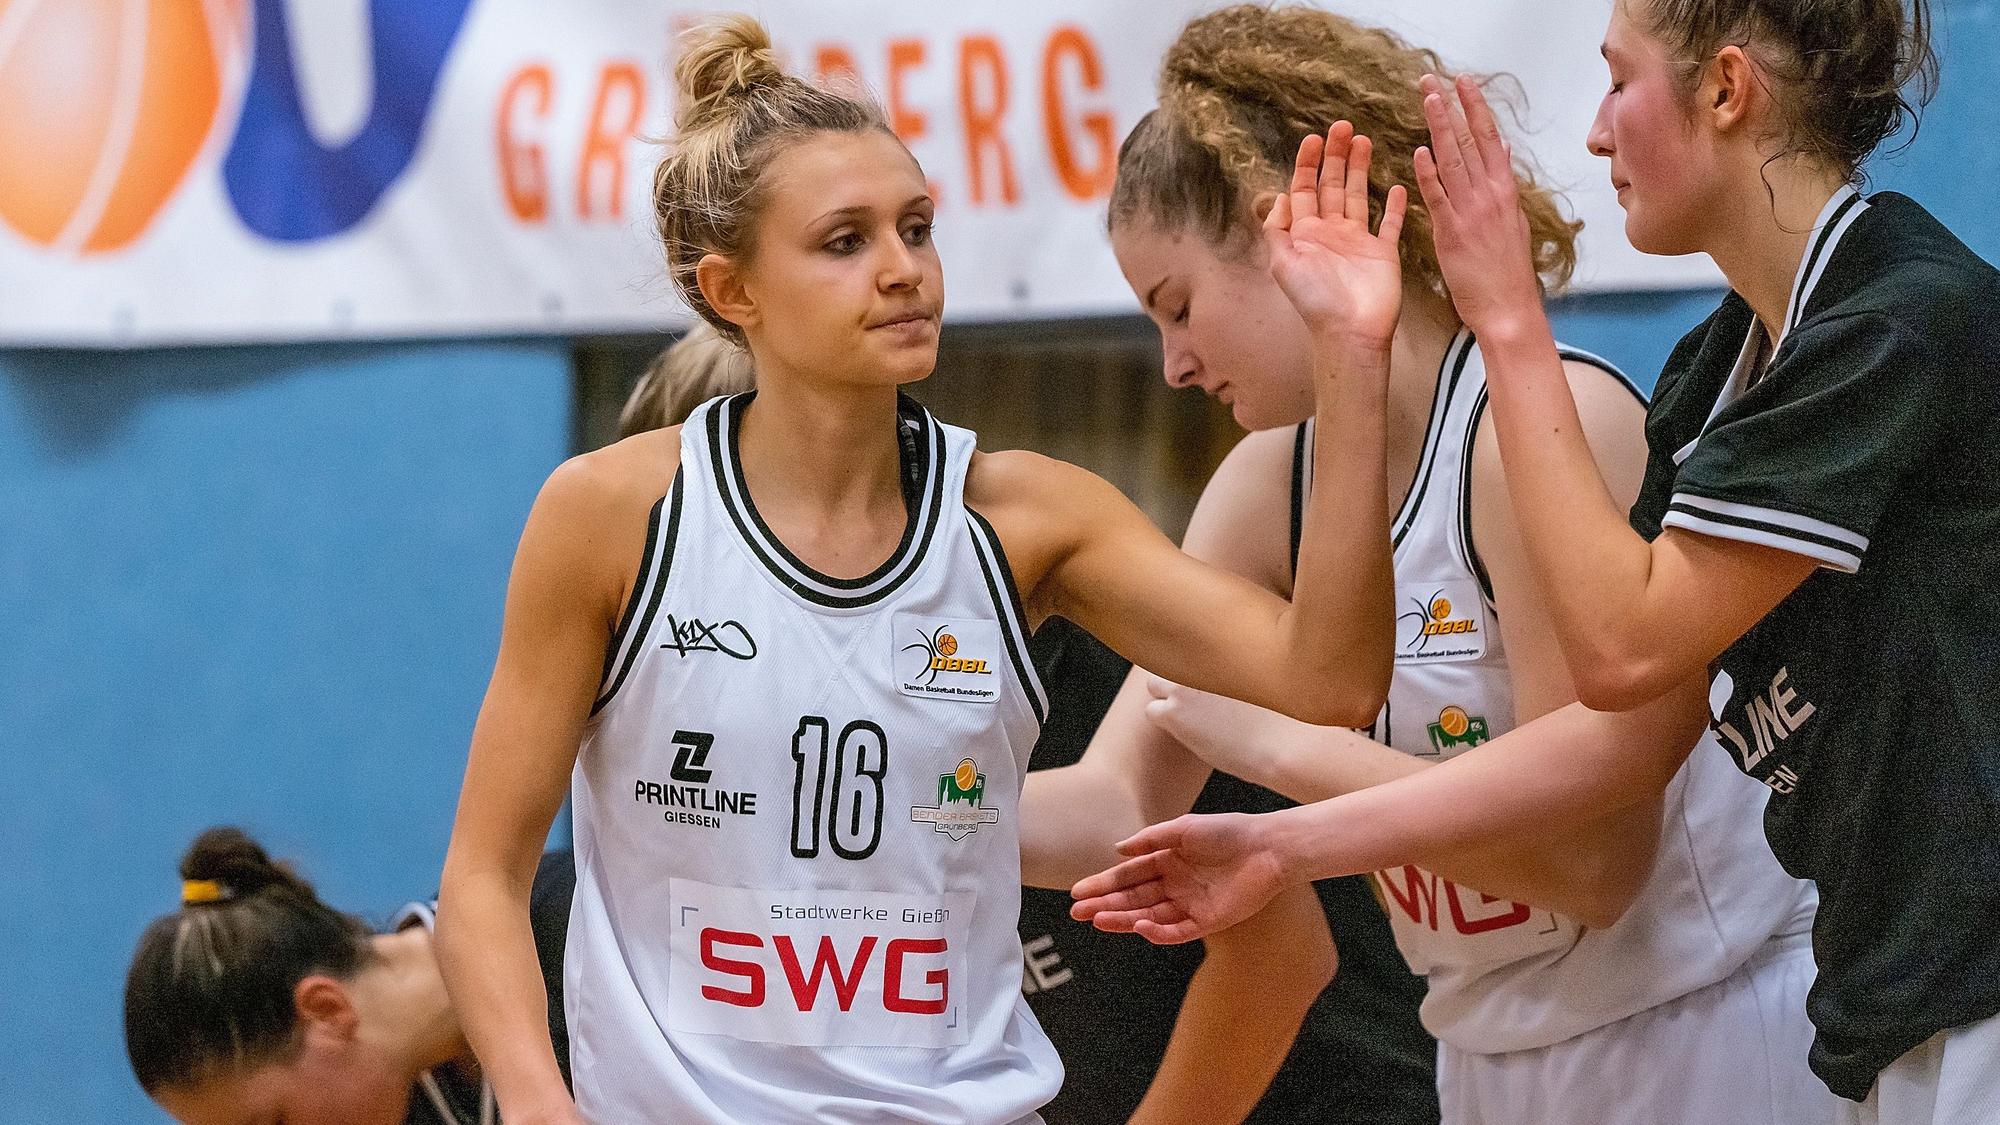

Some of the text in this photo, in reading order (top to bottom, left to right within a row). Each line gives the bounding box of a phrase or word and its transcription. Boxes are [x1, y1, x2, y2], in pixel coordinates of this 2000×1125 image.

[1424, 619, 1478, 635] DBBL
[931, 656, 992, 674] DBBL
[904, 683, 924, 691] Damen
[925, 685, 956, 694] Basketball
[635, 780, 757, 815] PRINTLINE
[791, 716, 888, 861] 16
[664, 811, 721, 829] GIESSEN
[911, 810, 957, 821] BENDER
[770, 904, 888, 921] Stadtwerke
[700, 927, 949, 1015] SWG
